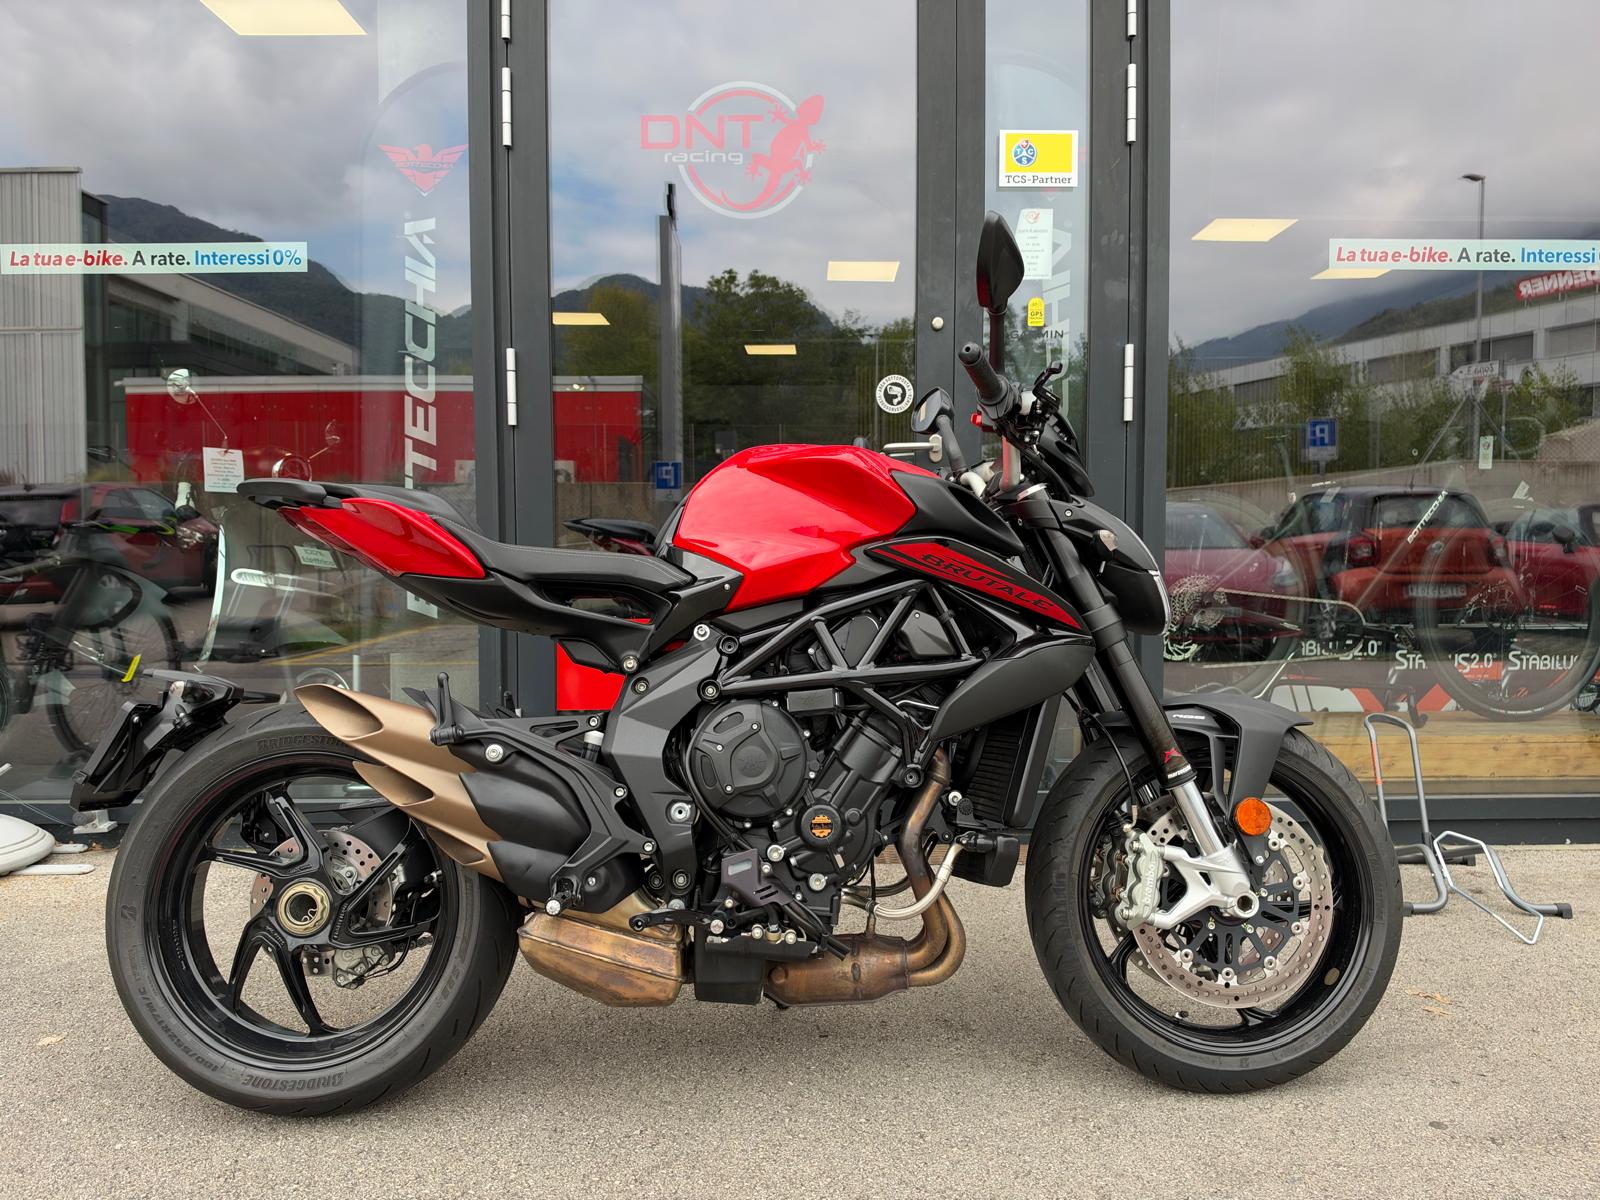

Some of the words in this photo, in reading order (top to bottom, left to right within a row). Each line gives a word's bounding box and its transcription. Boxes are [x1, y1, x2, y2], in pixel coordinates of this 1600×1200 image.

[640, 114, 764, 149] DNT
[664, 150, 743, 165] racing
[1005, 174, 1072, 184] TCS-Partner
[10, 250, 29, 266] La
[33, 251, 66, 266] tua
[66, 249, 128, 266] e-bike.
[132, 250, 146, 265] A
[151, 250, 190, 265] rate.
[195, 249, 270, 265] Interessi
[273, 249, 302, 265] 0%
[1336, 246, 1355, 262] La
[1360, 248, 1391, 262] tua
[1391, 246, 1452, 263] e-bike.
[1457, 247, 1471, 262] A
[1475, 248, 1515, 263] rate.
[1521, 247, 1595, 263] Interessi
[1011, 330, 1064, 339] GAMIN
[404, 217, 438, 619] TECCHIA
[921, 553, 1054, 611] BRUTALE
[242, 1071, 345, 1092] BRIDGESTONE
